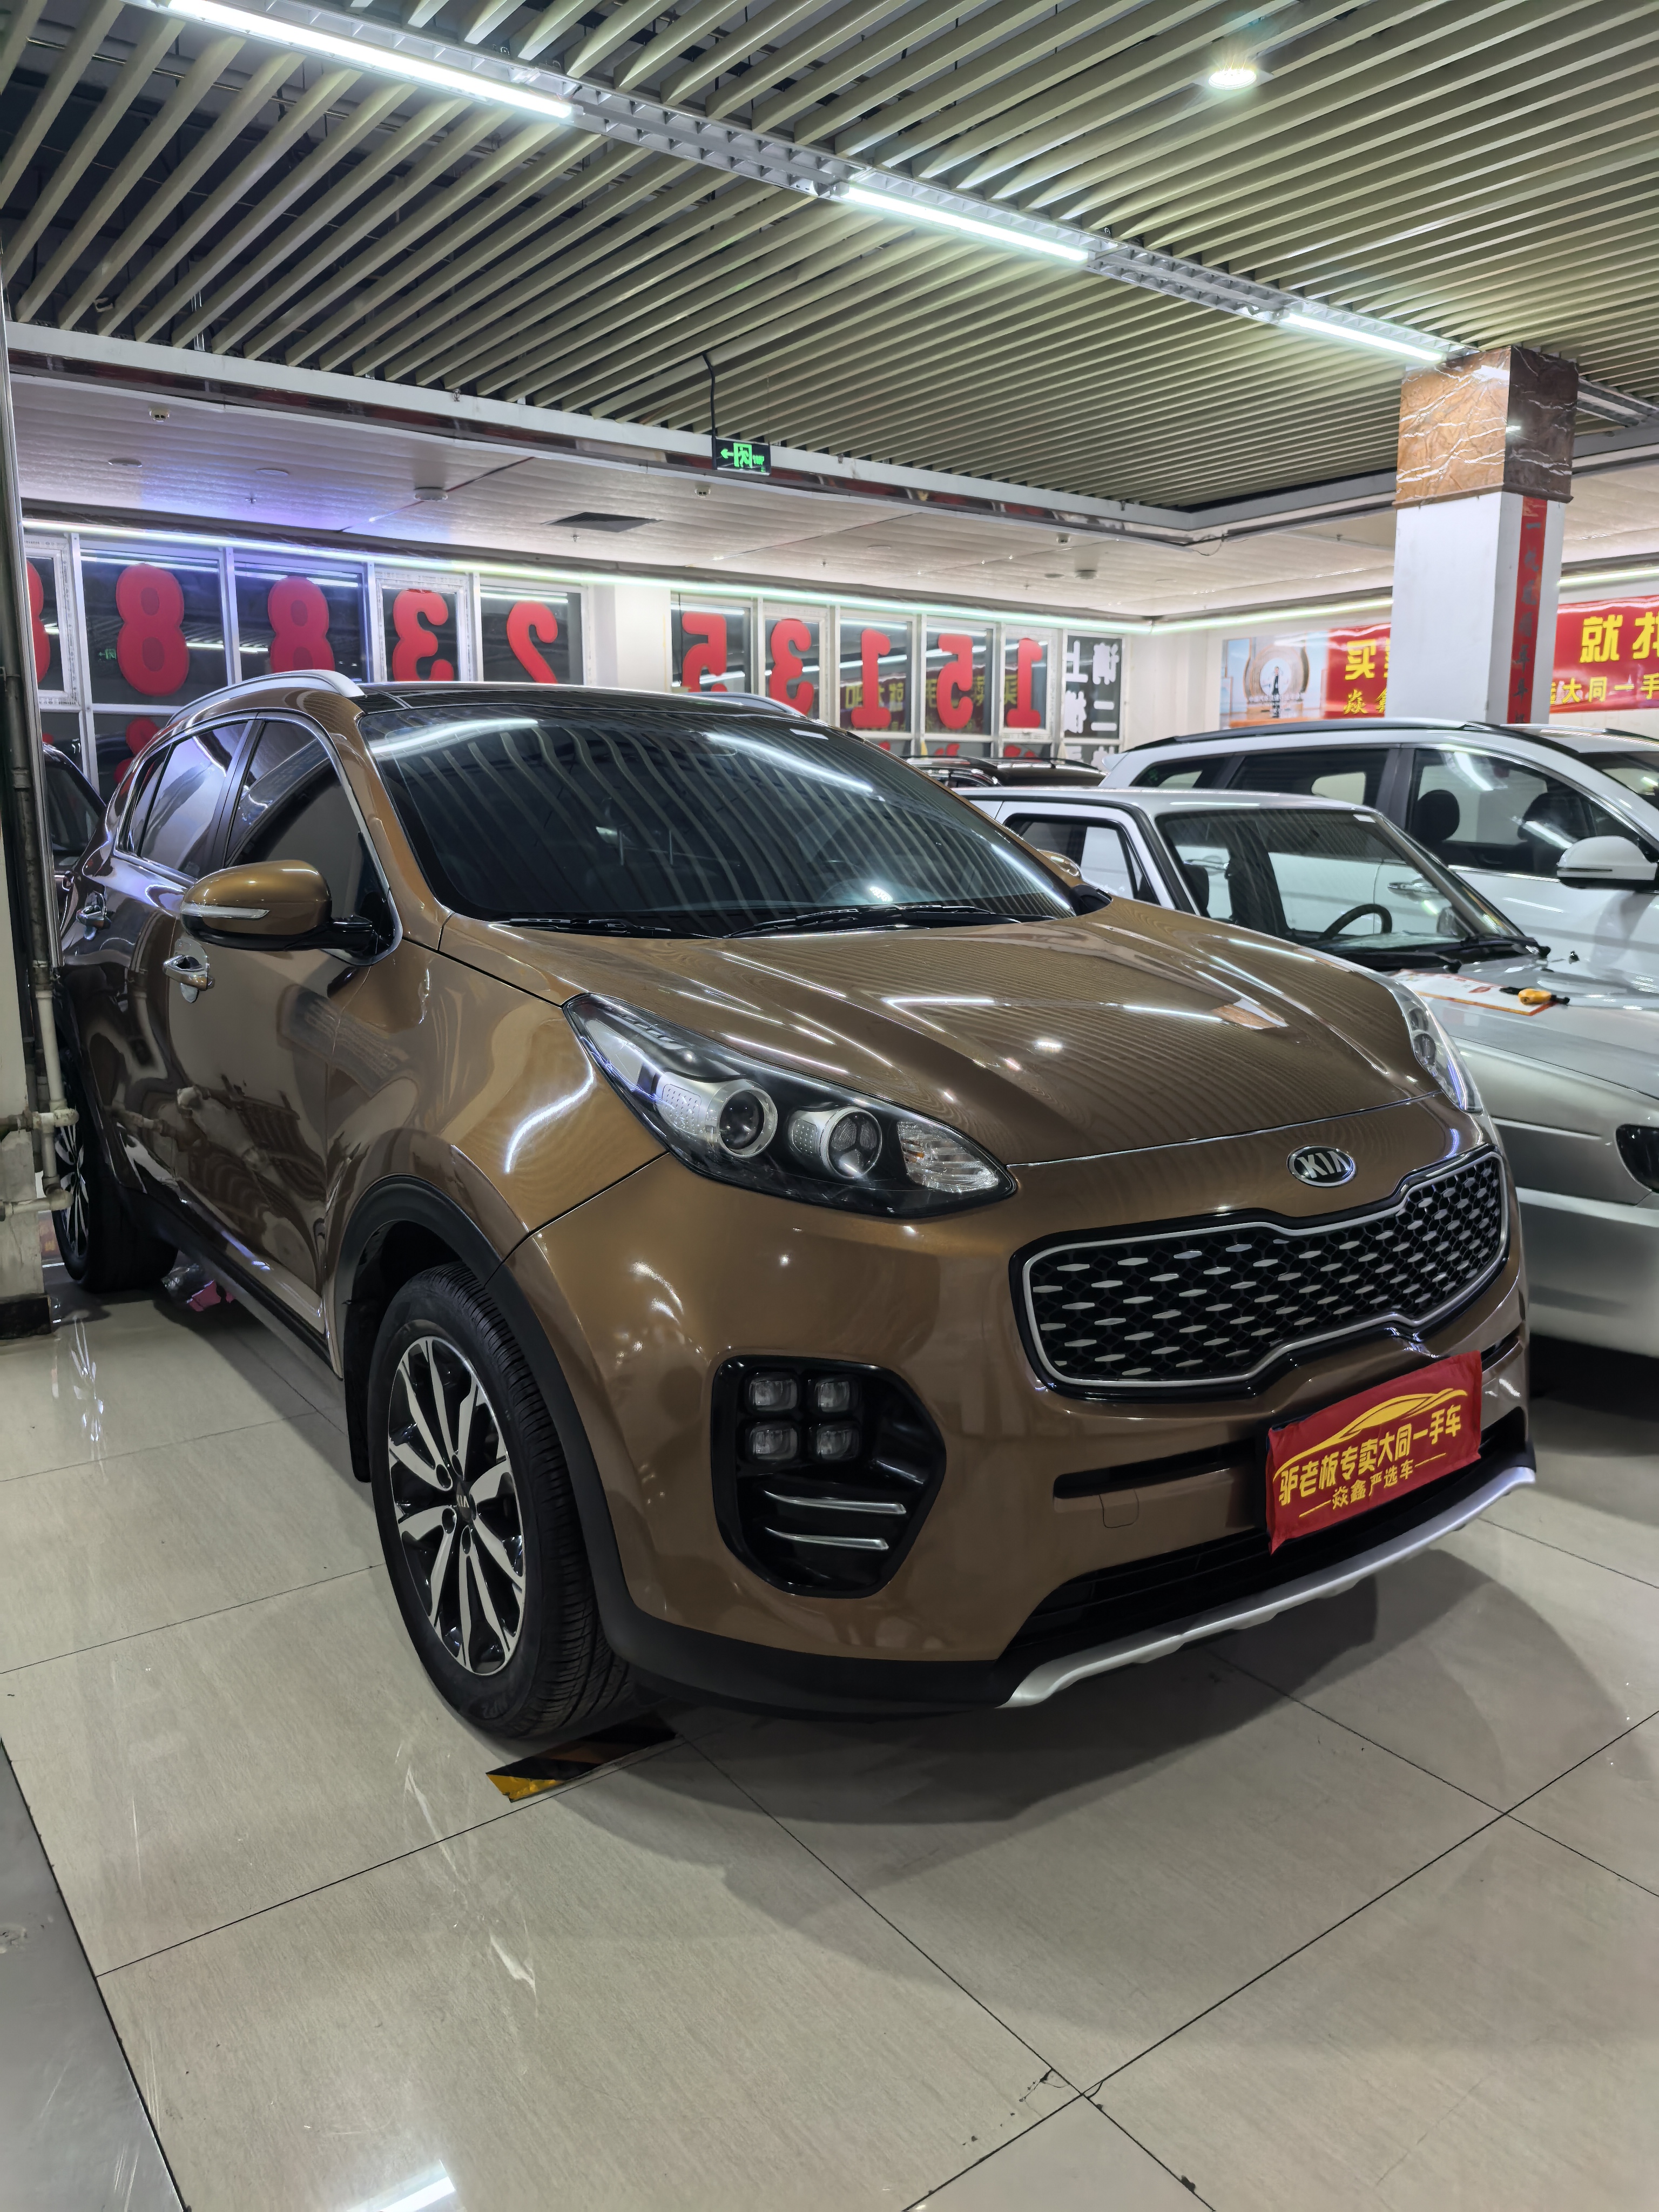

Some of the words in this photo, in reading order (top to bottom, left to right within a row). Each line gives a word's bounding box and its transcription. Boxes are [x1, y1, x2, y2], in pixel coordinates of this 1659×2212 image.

[1345, 638, 1391, 680] 买
[1297, 1151, 1350, 1179] KIA
[1278, 1404, 1461, 1506] 驴老板专卖大同一手车
[1331, 1459, 1414, 1510] 焱鑫严选车
